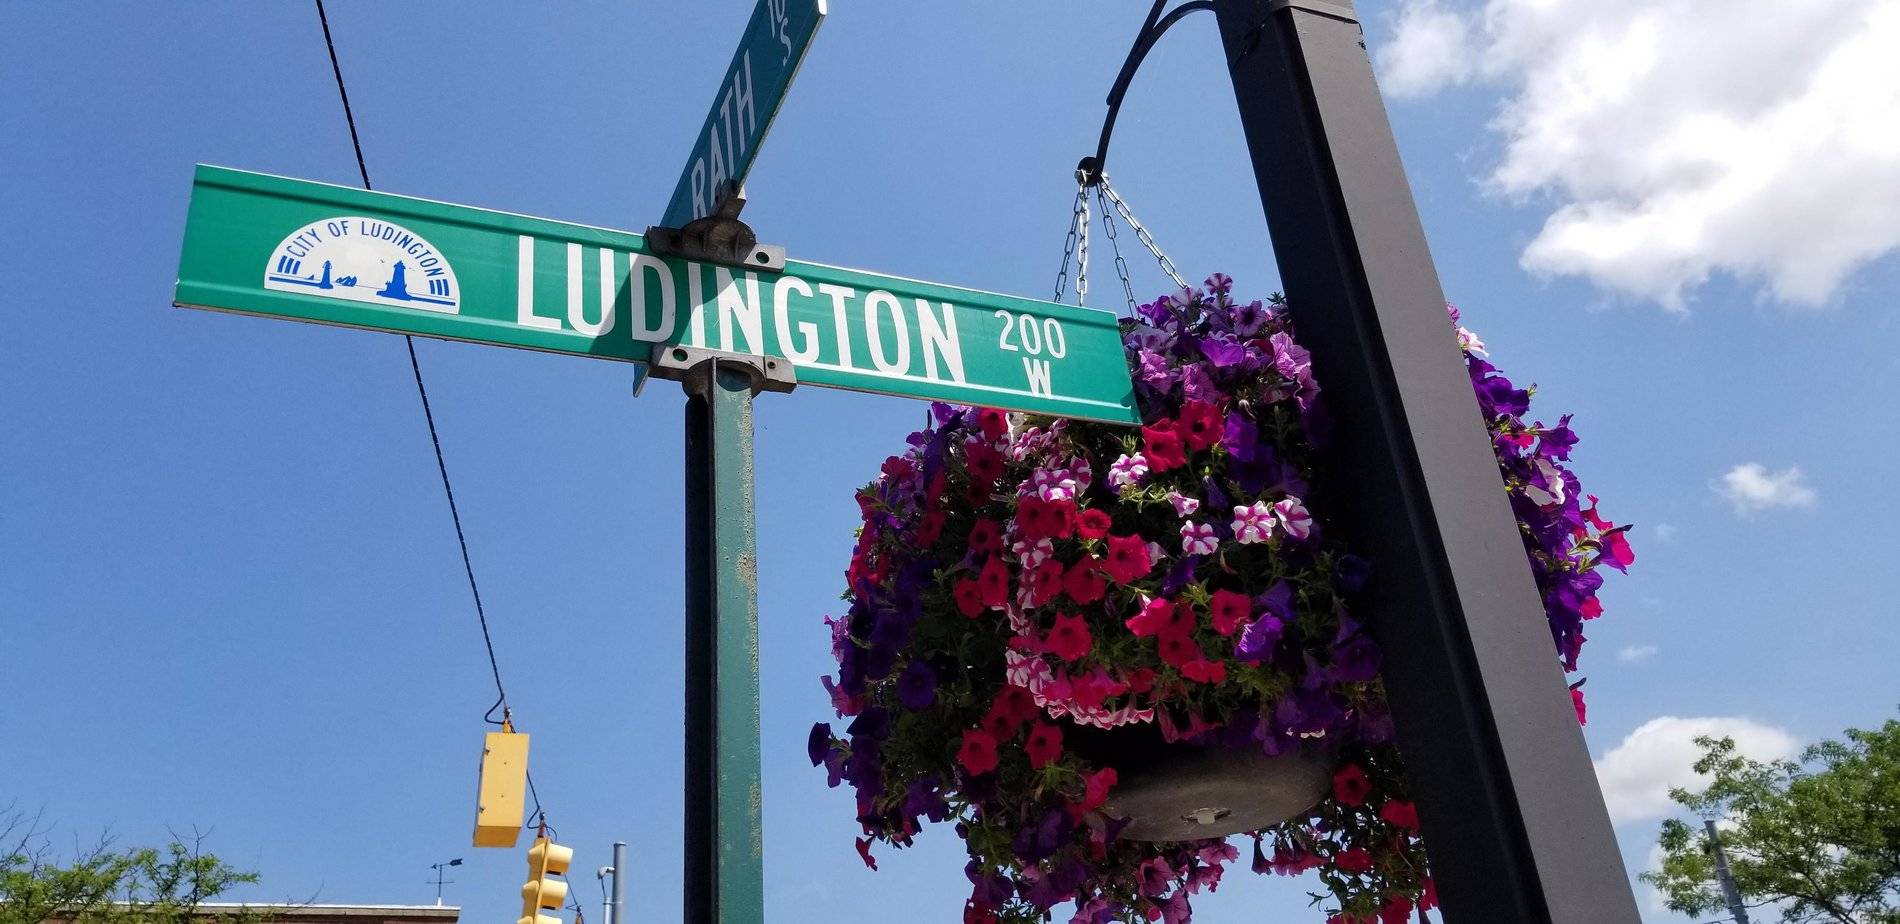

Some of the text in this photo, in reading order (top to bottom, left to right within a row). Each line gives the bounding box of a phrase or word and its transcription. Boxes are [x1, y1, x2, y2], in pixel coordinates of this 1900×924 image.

[780, 17, 791, 67] S
[691, 49, 755, 220] RATH
[287, 220, 444, 277] CITY OF LUDINGTON
[517, 235, 966, 384] LUDINGTON
[995, 310, 1066, 359] 200
[1023, 358, 1053, 398] W
